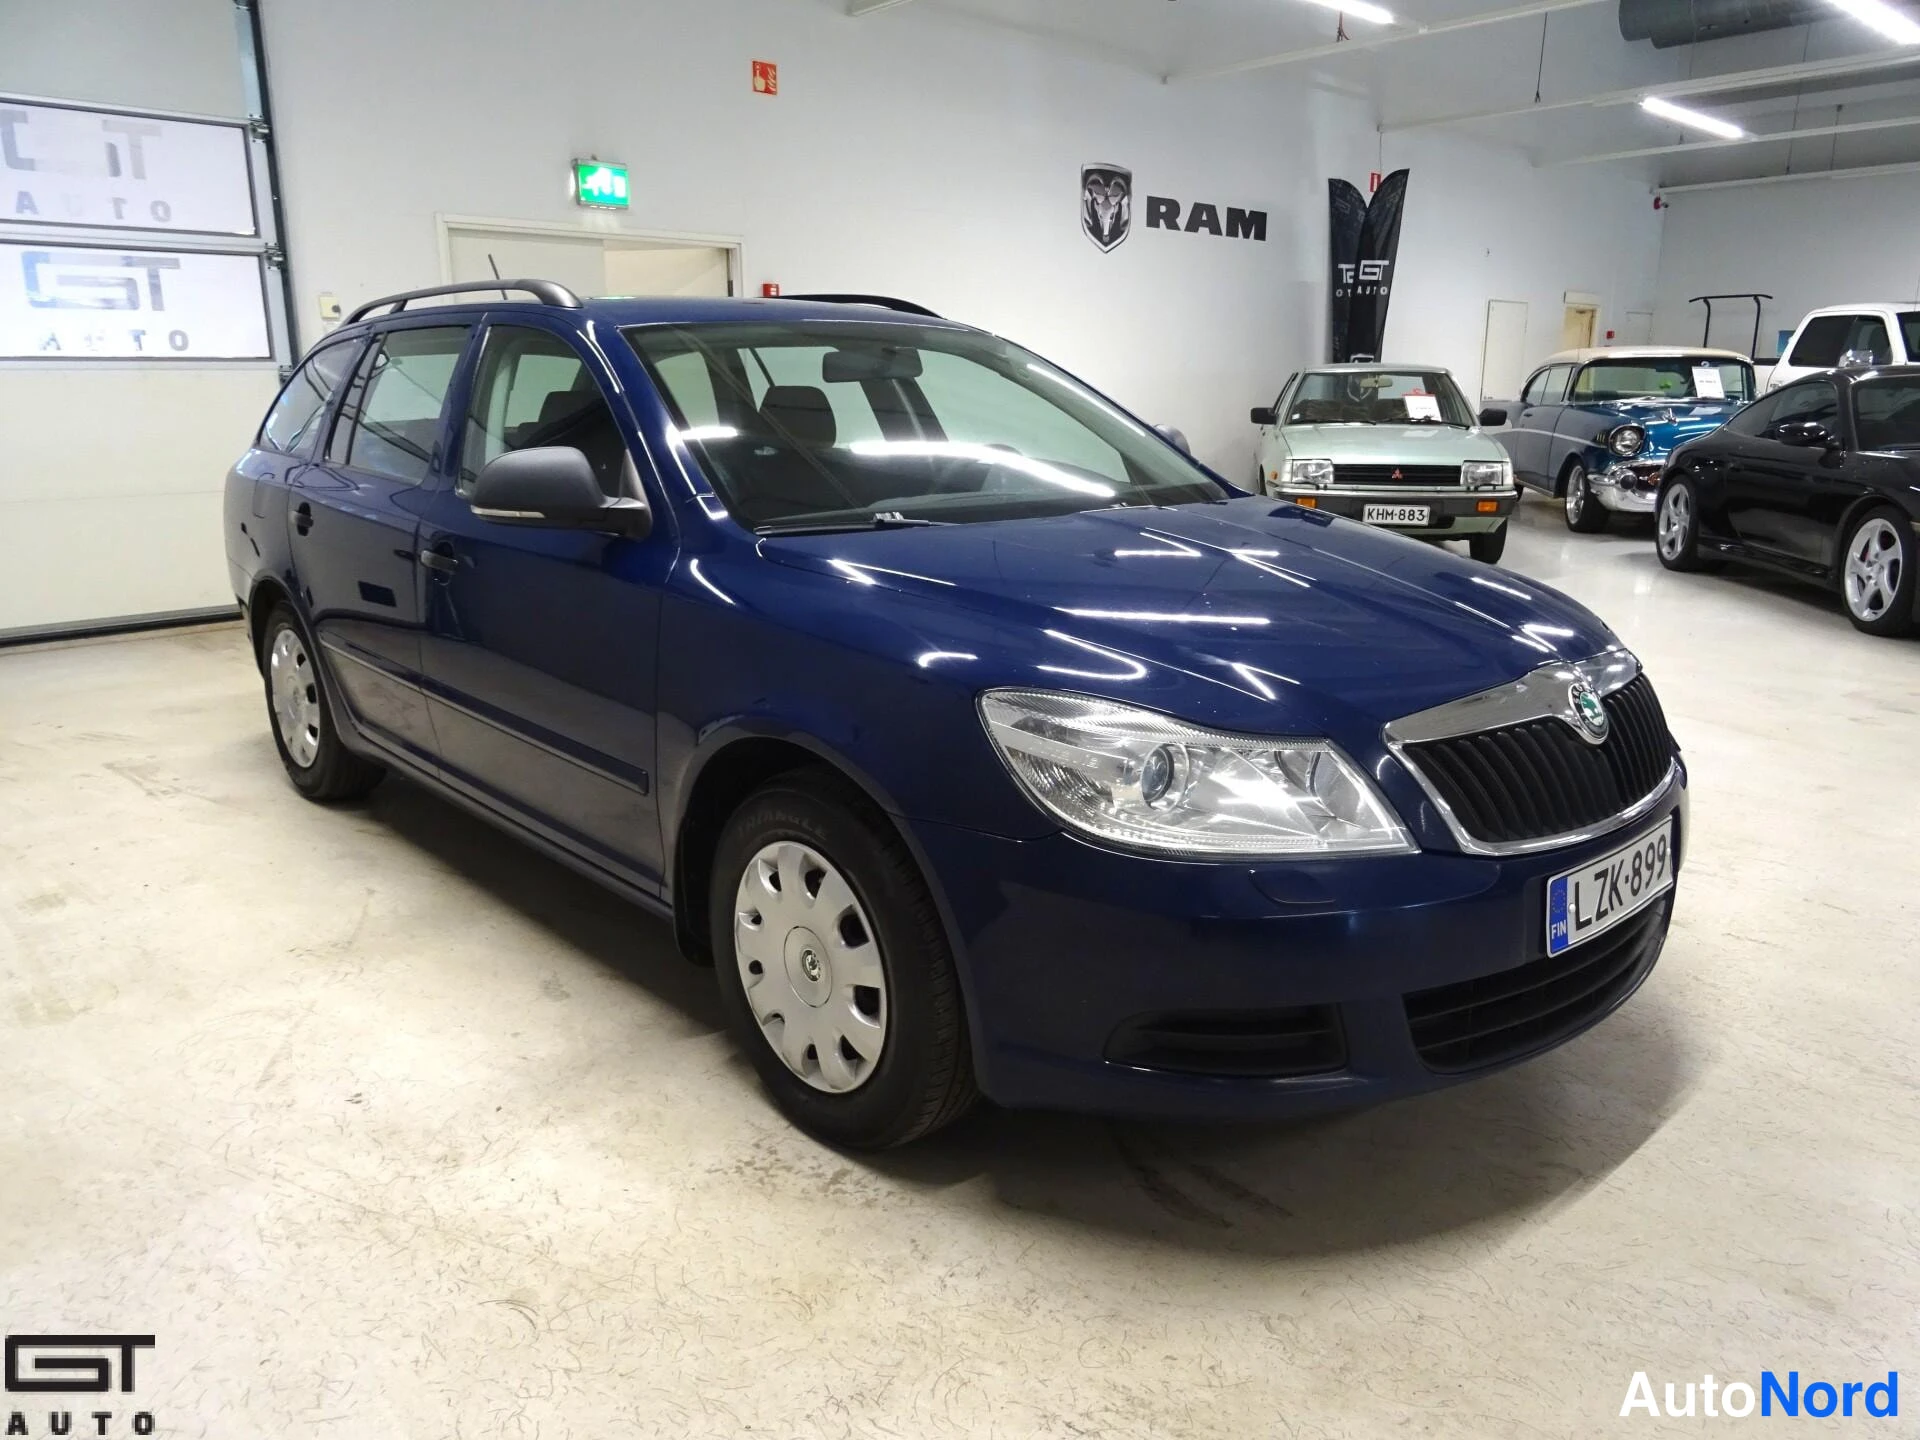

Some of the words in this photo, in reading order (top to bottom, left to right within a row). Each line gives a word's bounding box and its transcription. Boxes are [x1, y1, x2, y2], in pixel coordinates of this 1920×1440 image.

[1146, 195, 1267, 242] RAM
[1366, 505, 1426, 522] KHM-883
[1575, 834, 1667, 931] LZK-899
[1552, 919, 1567, 939] FIN
